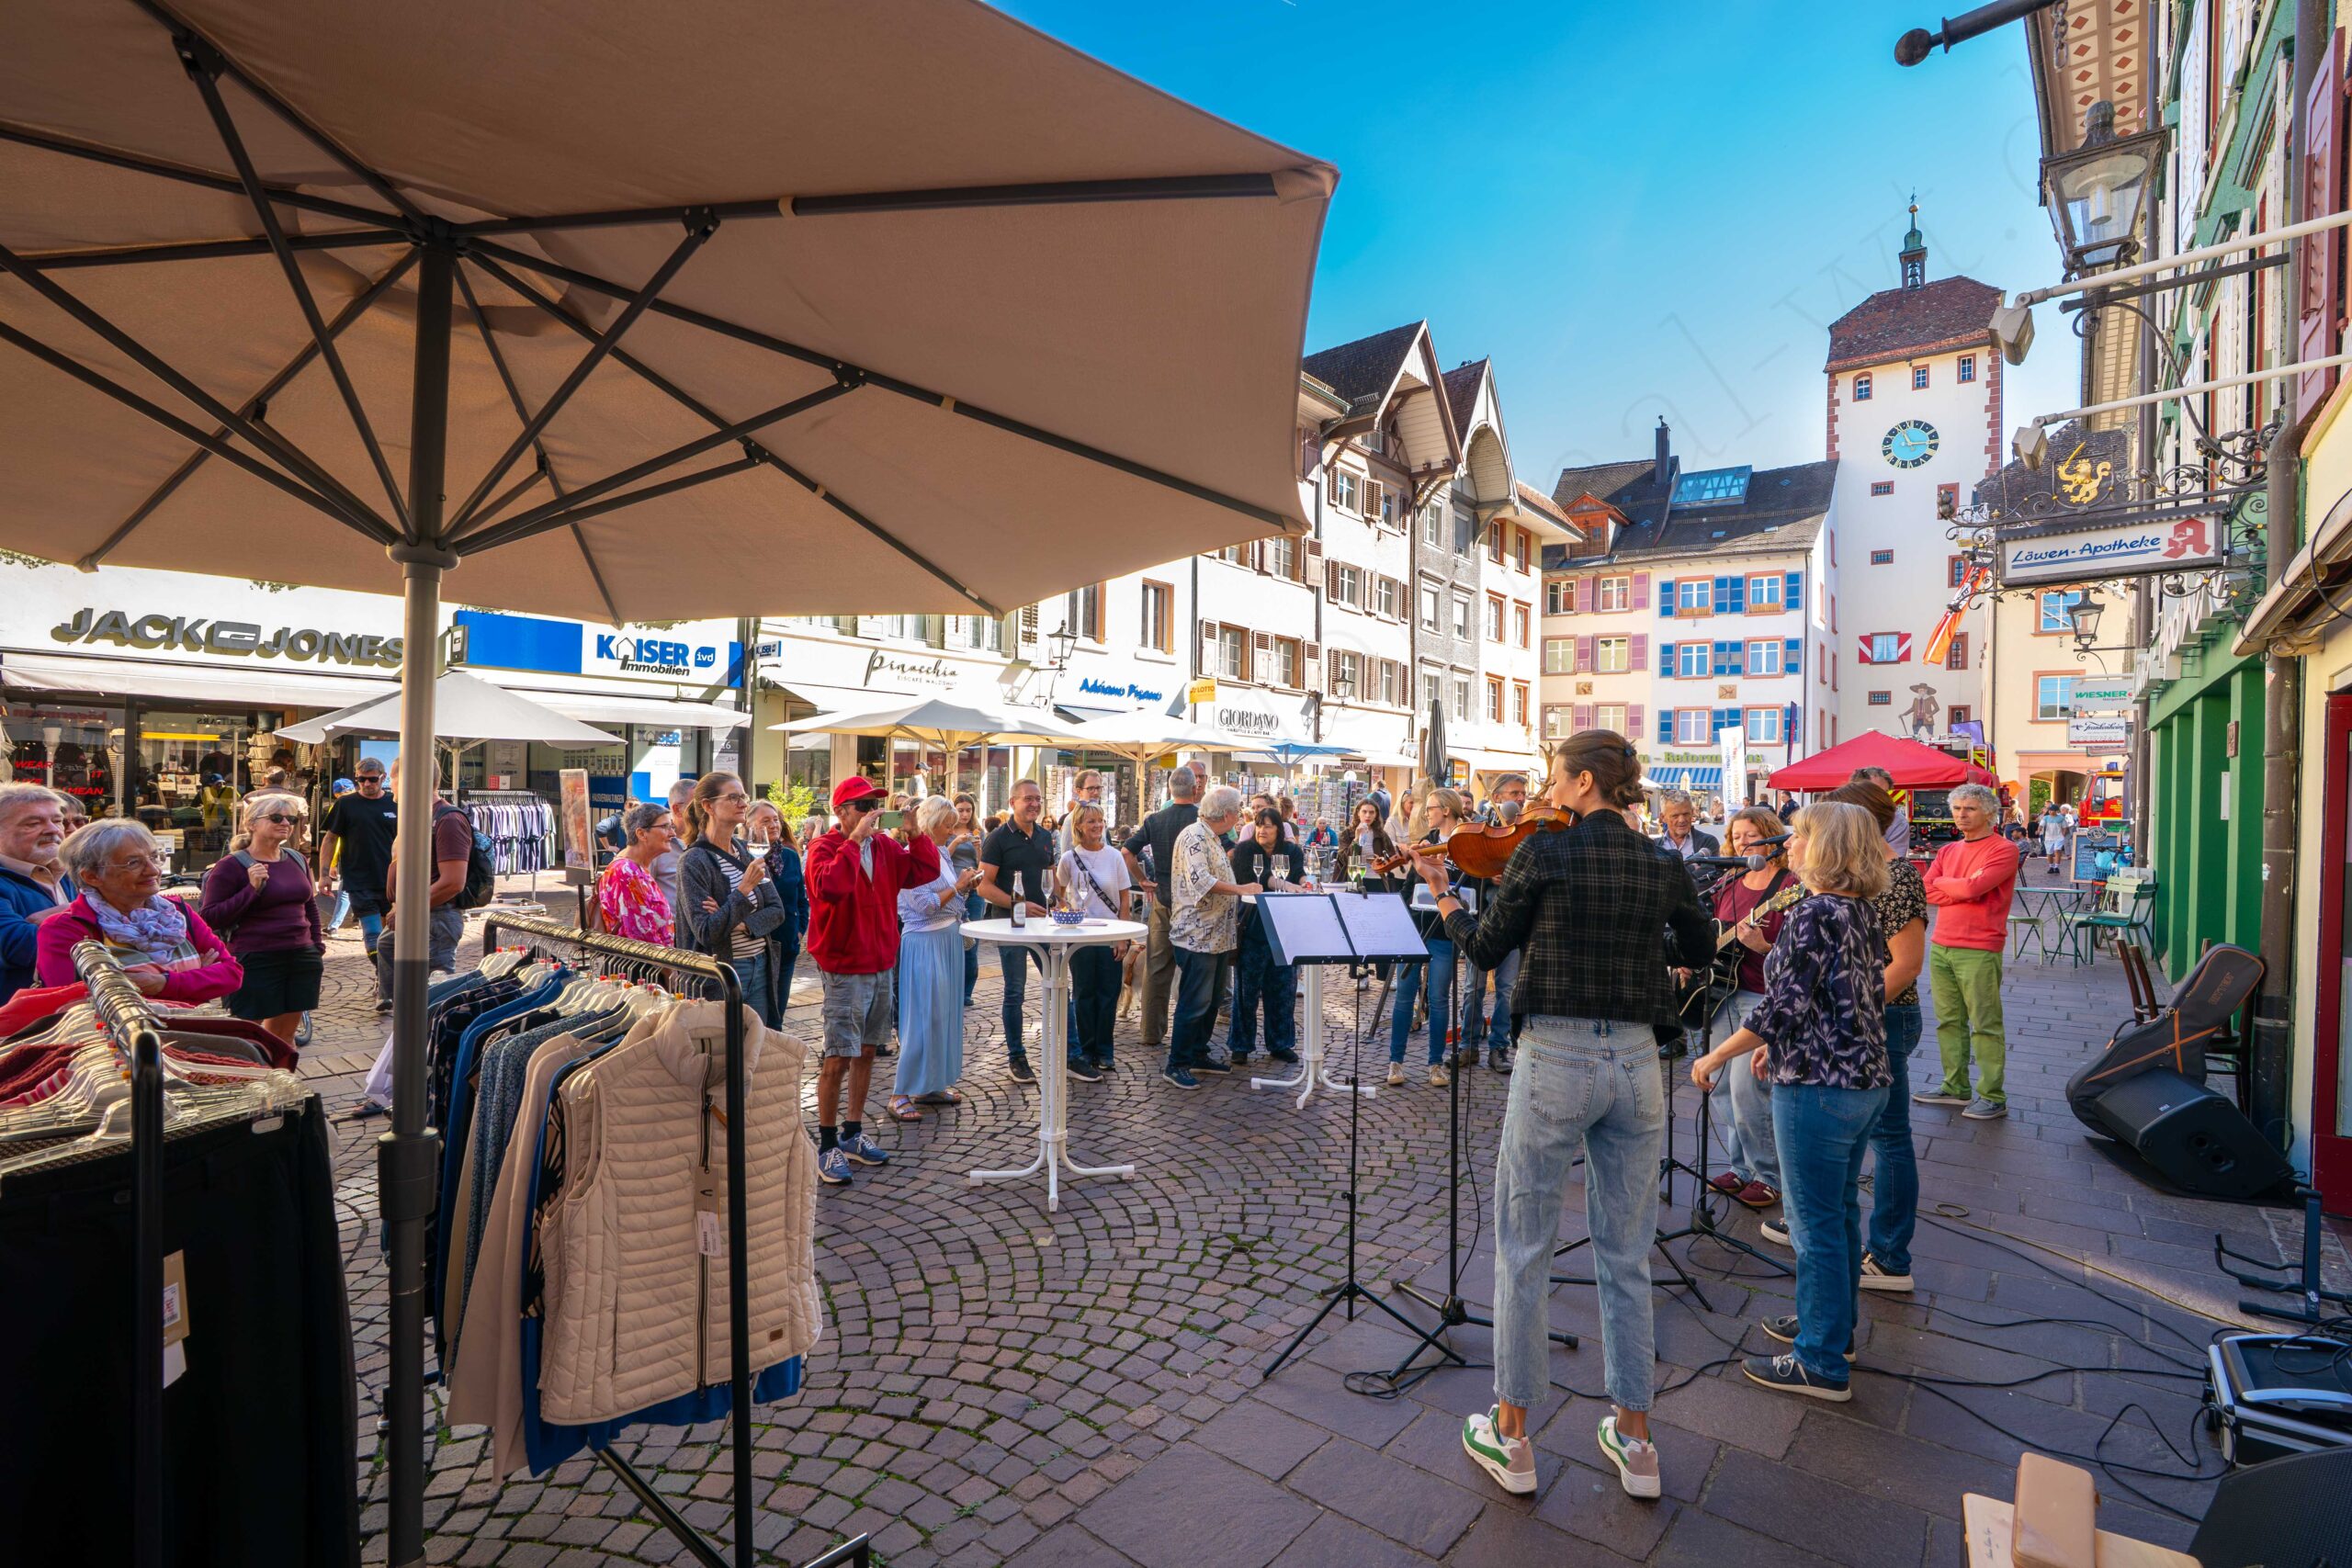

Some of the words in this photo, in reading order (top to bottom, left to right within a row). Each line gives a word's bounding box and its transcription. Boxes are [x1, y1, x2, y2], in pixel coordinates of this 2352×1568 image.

[2011, 535, 2161, 564] Löwen-Apotheke
[58, 607, 209, 648] JACK
[262, 626, 403, 666] JONES
[696, 651, 715, 663] ivd
[619, 654, 691, 677] Immobilien
[1197, 685, 1215, 694] LOTTO
[1218, 708, 1279, 731] GIORDANO
[15, 761, 54, 769] WEAR
[1664, 751, 1764, 763] Reformus
